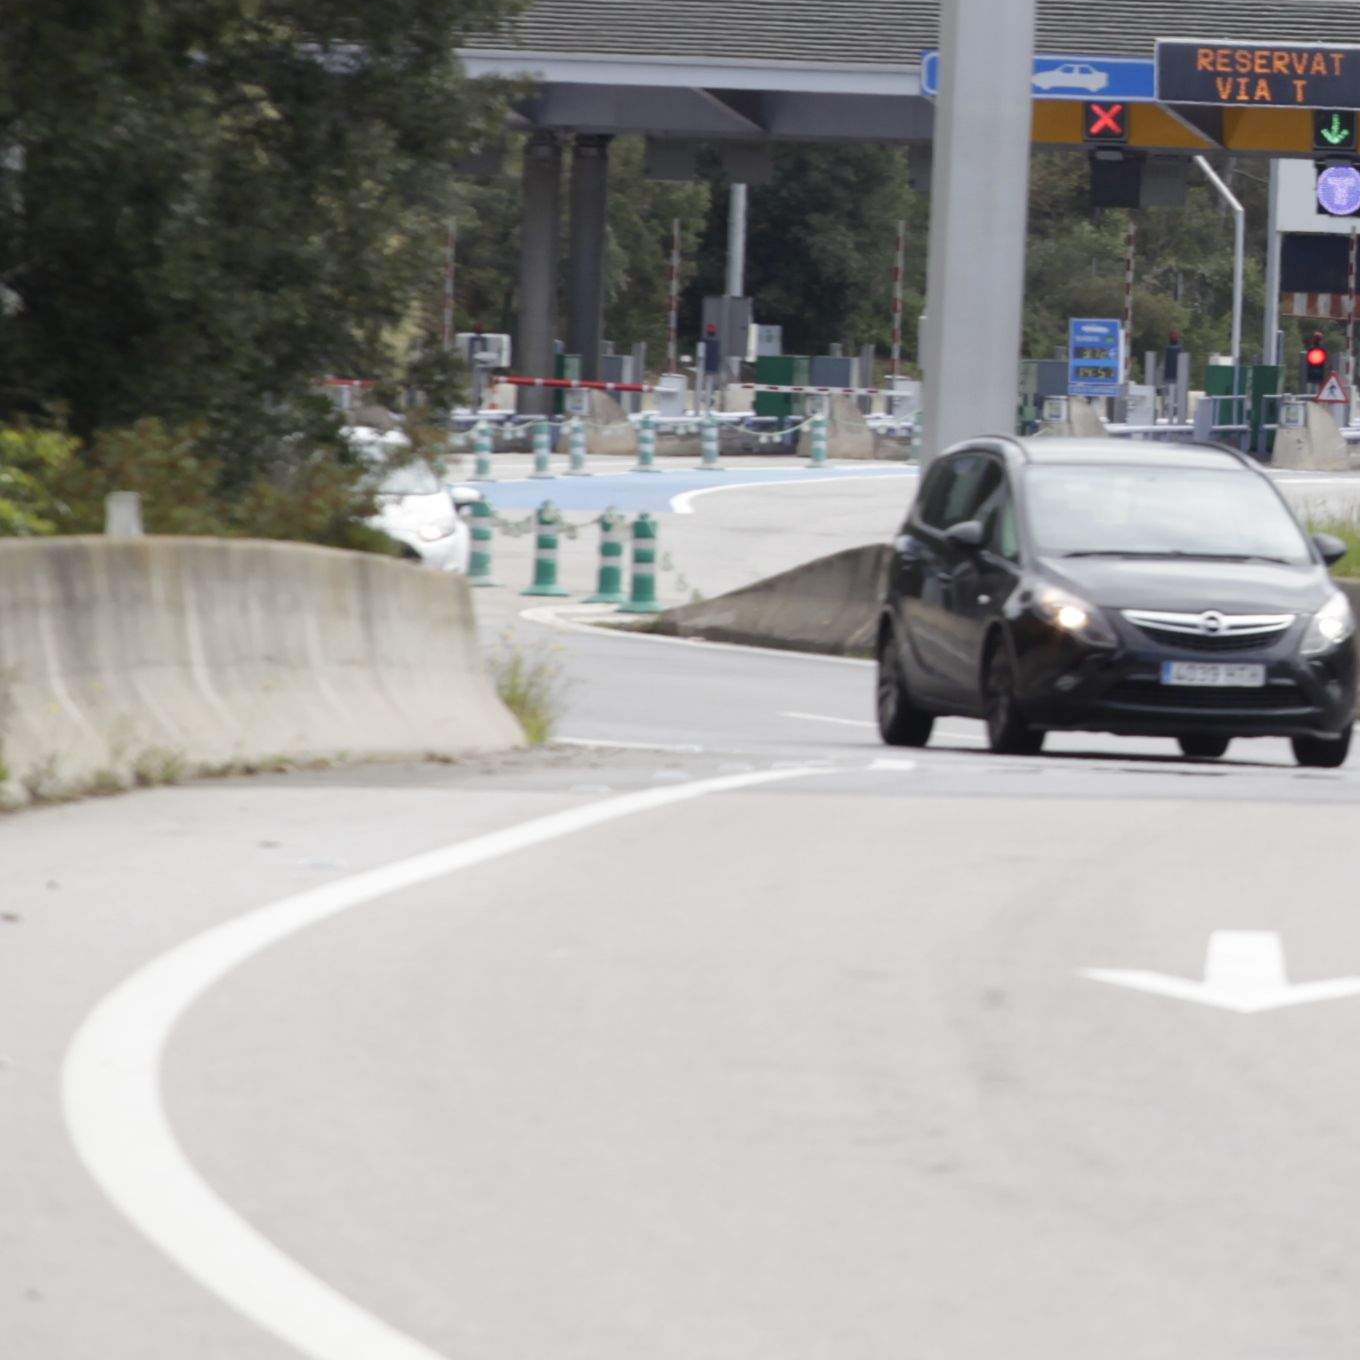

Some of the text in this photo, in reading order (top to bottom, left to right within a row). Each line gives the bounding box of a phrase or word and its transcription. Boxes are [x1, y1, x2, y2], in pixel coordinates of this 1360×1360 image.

[1196, 47, 1345, 76] RESERVAT
[1215, 76, 1307, 104] VIA T
